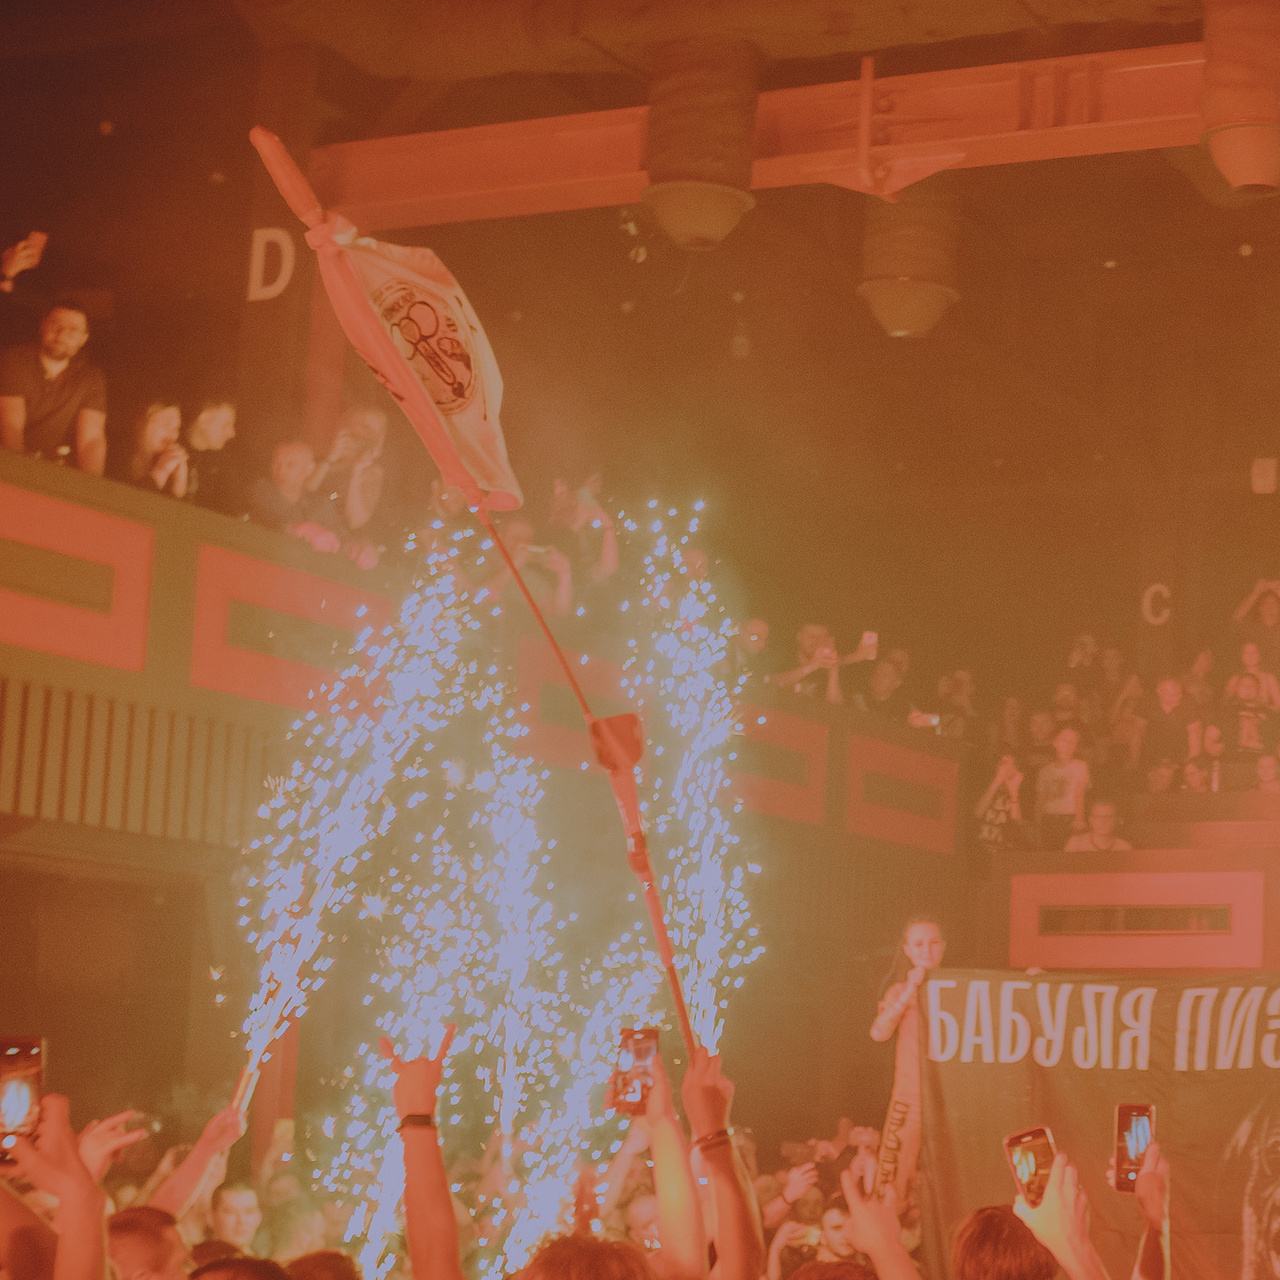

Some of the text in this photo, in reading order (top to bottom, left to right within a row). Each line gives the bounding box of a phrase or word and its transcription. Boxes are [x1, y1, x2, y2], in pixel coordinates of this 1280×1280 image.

[246, 227, 295, 301] D
[1141, 582, 1172, 626] C
[927, 979, 1157, 1071] БАБУЛЯ
